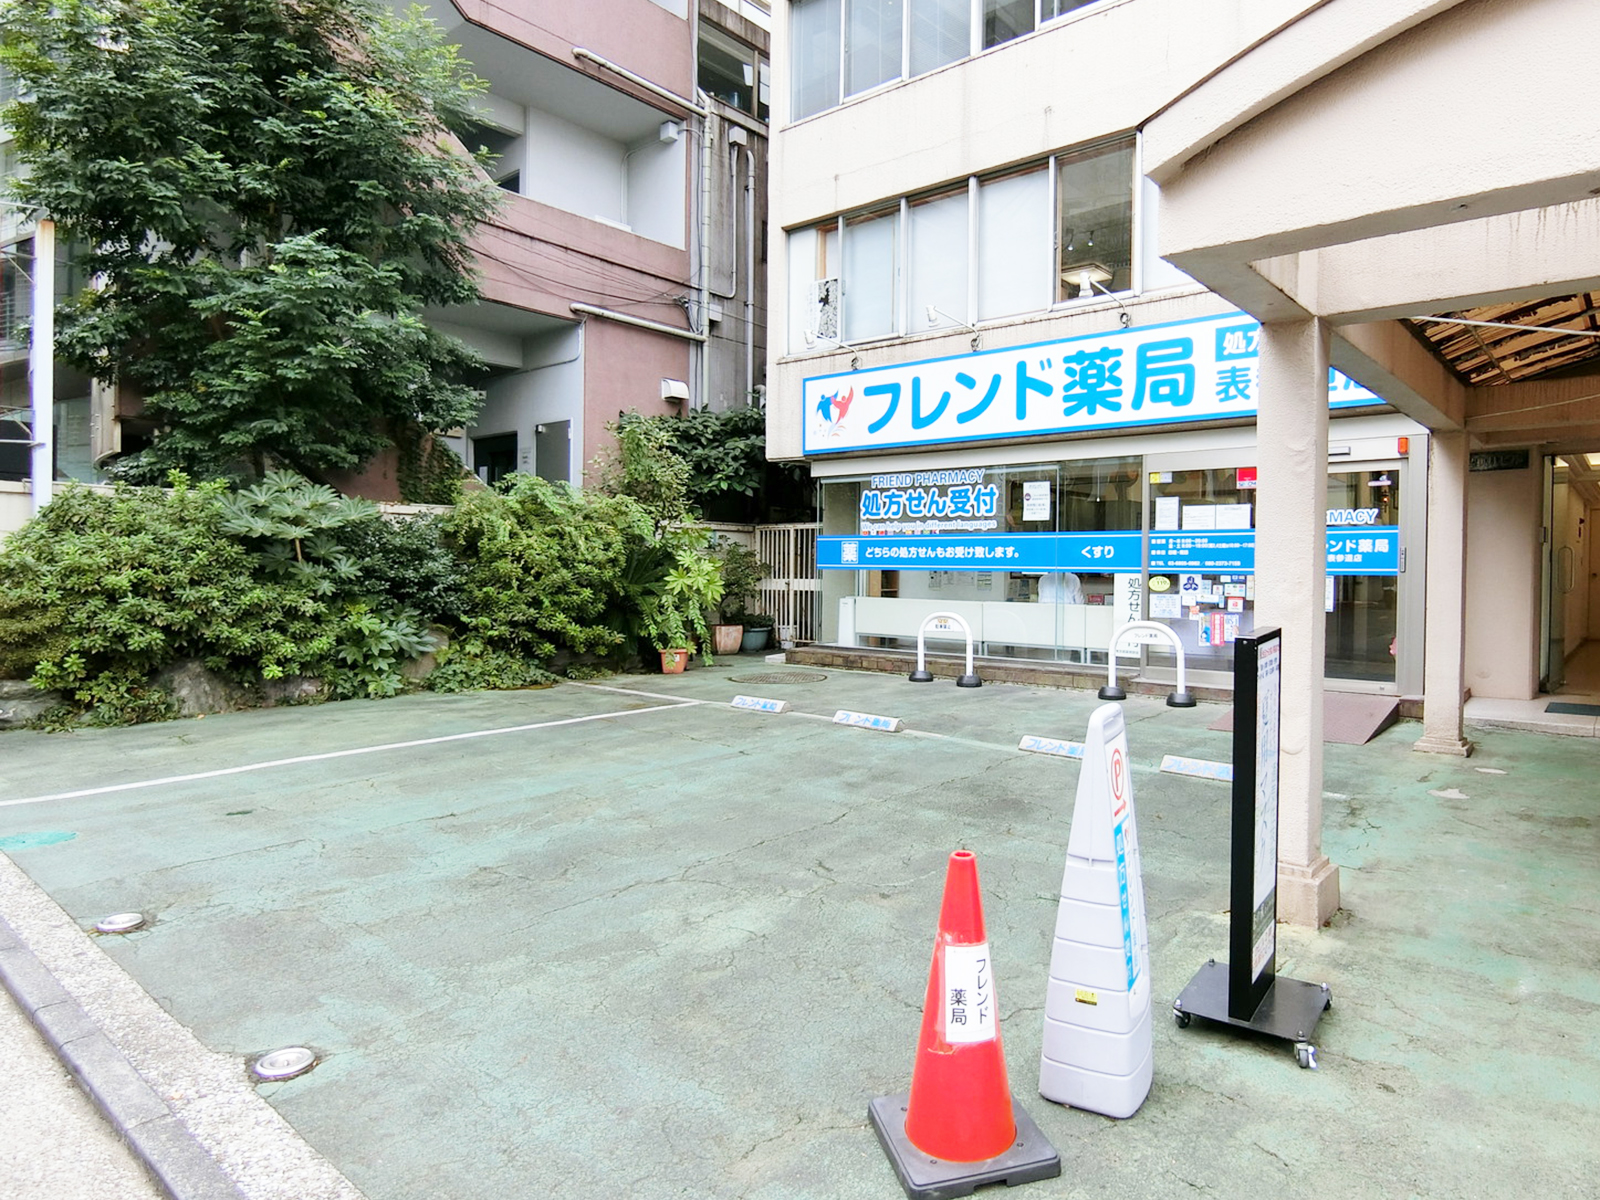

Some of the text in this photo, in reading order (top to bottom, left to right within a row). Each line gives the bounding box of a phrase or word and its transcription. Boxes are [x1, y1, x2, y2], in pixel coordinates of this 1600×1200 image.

[863, 336, 1196, 435] フレンド薬局
[1216, 366, 1259, 402] 表
[871, 469, 985, 488] FRIEND PHARMACY
[861, 484, 998, 519] 処方せん受付
[1327, 508, 1378, 525] MACY
[865, 546, 1019, 559] どちらの処方せんもお受け致します。
[1081, 546, 1114, 558] くすり
[1327, 539, 1389, 553] ンド薬局
[976, 958, 988, 1024] フレンド
[950, 988, 967, 1026] 薬局
